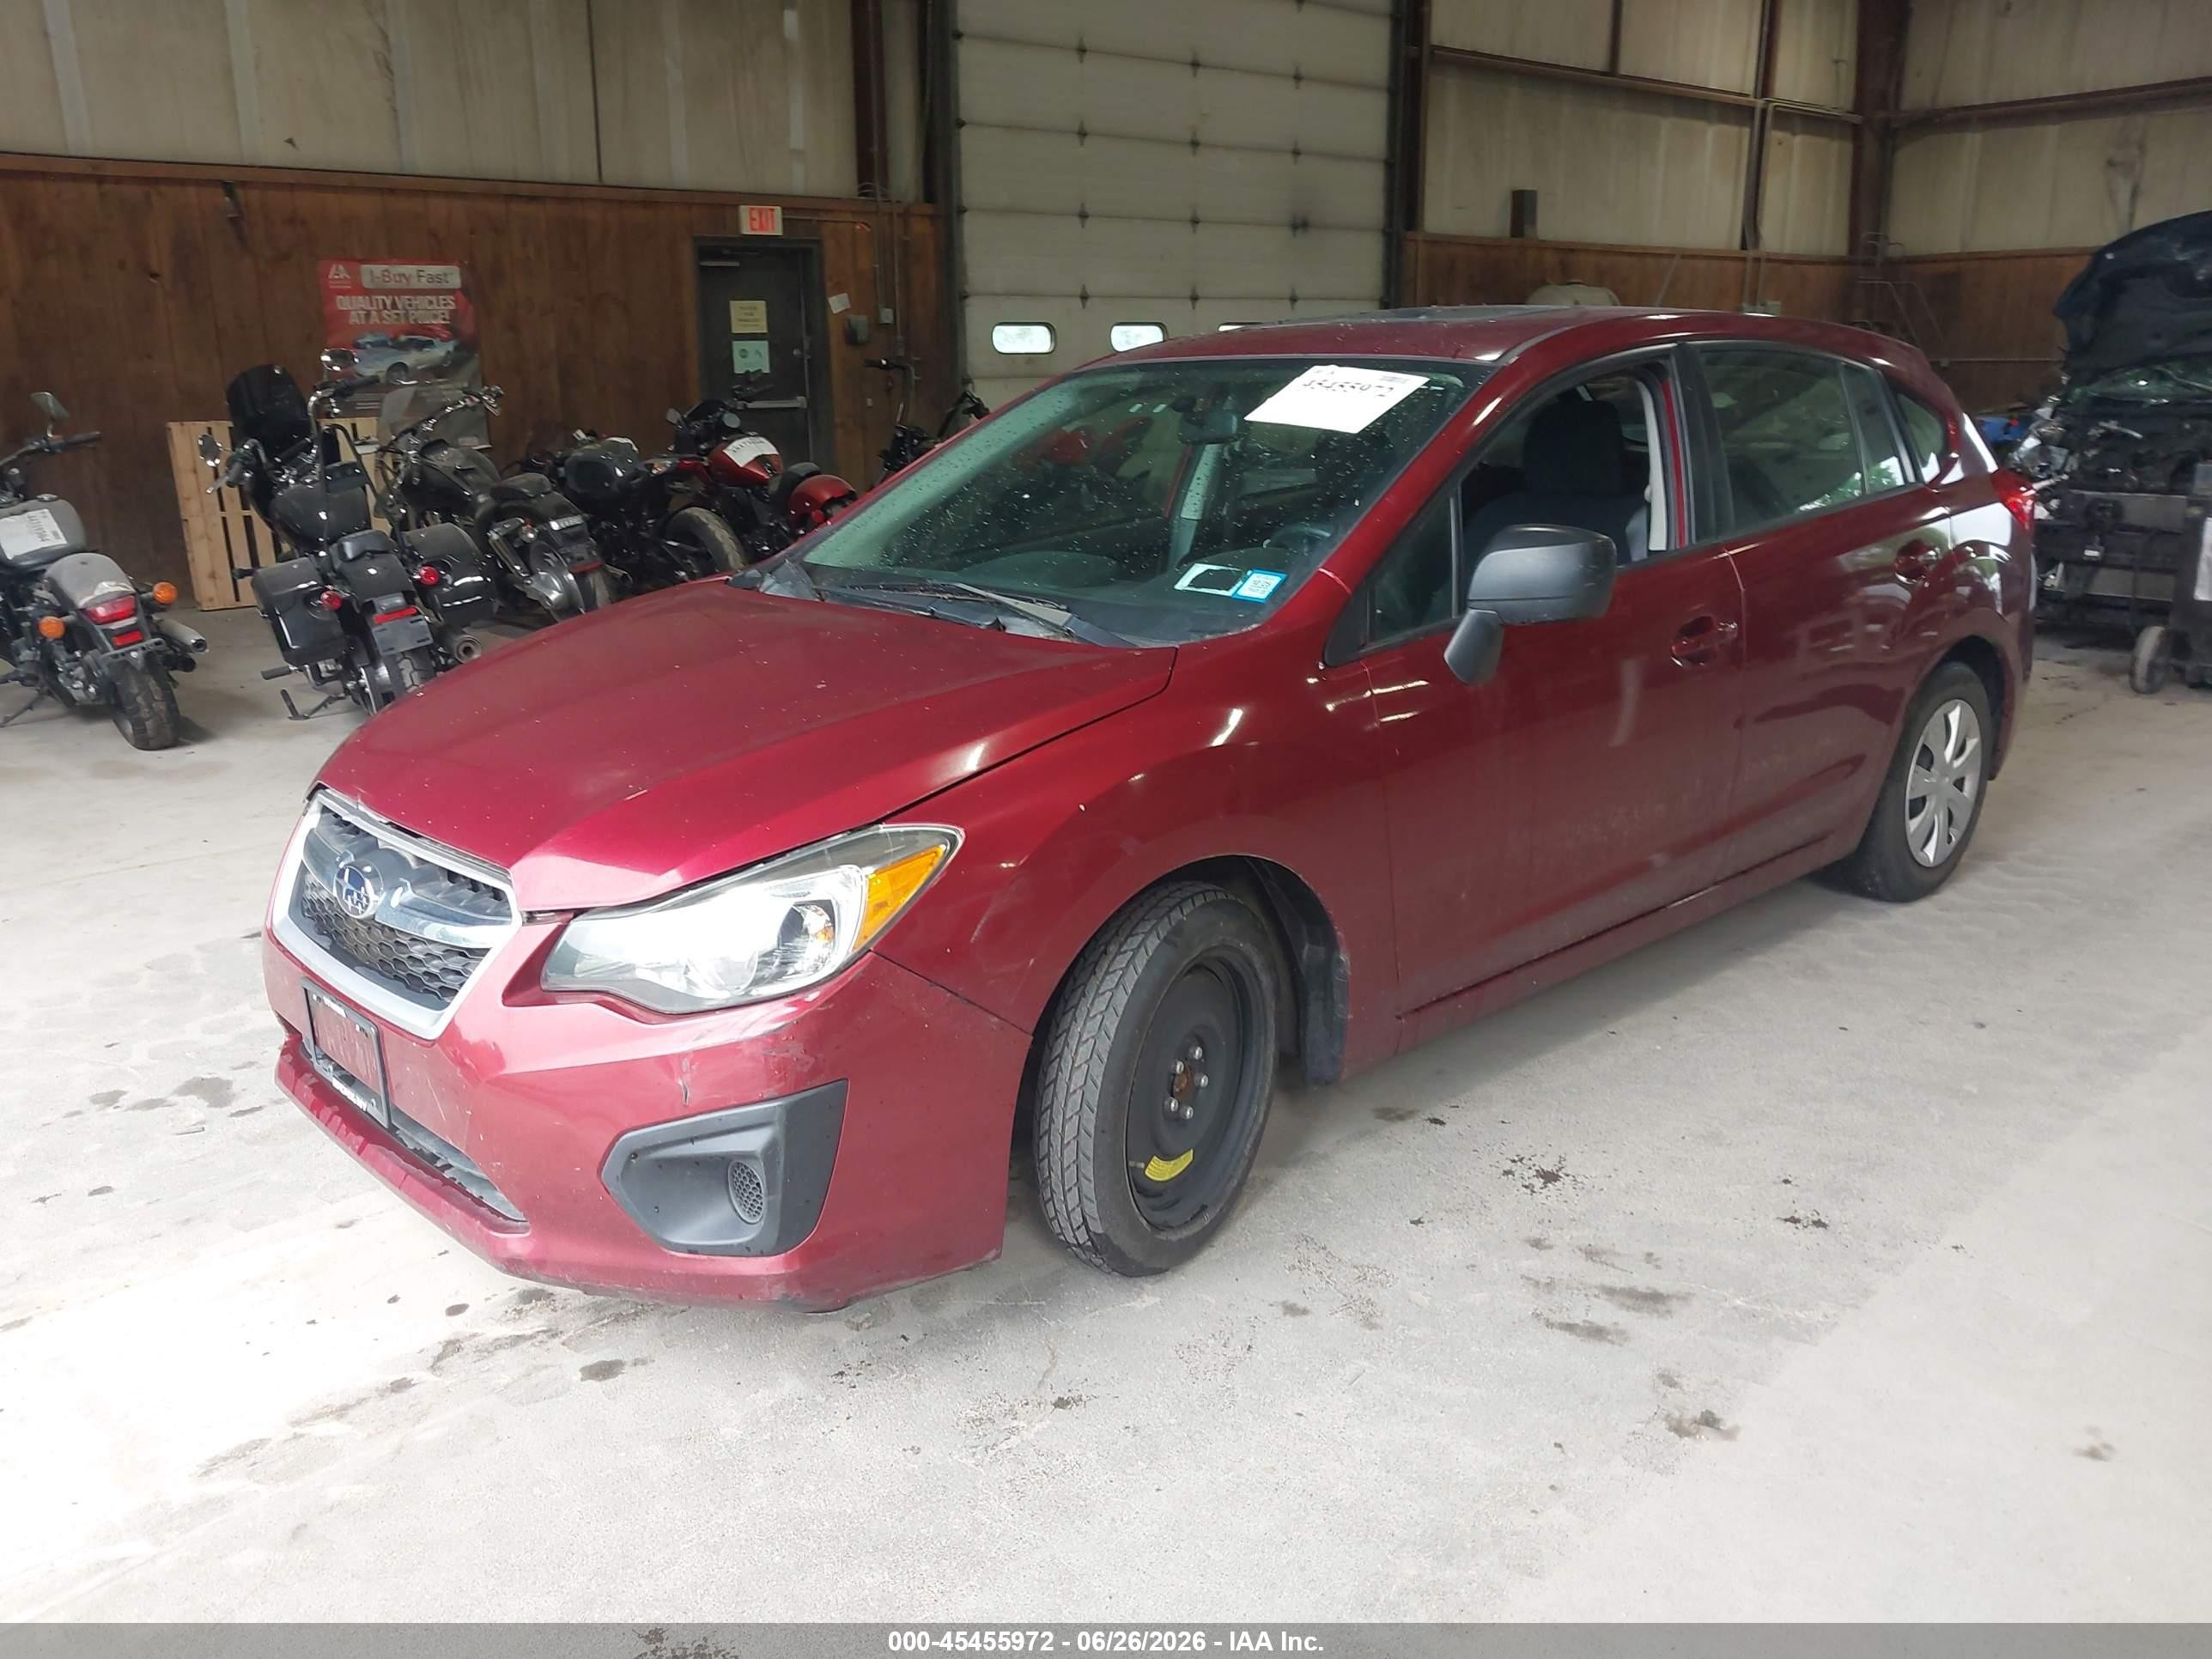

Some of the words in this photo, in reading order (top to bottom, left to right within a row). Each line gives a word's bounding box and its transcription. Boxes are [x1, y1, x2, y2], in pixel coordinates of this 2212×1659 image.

[749, 207, 776, 232] EXIT
[336, 295, 392, 310] QUALITY
[394, 296, 456, 310] VEHICLES
[349, 310, 366, 325] AT
[369, 310, 380, 325] A
[382, 310, 407, 325] SET
[410, 310, 451, 324] PRICE!
